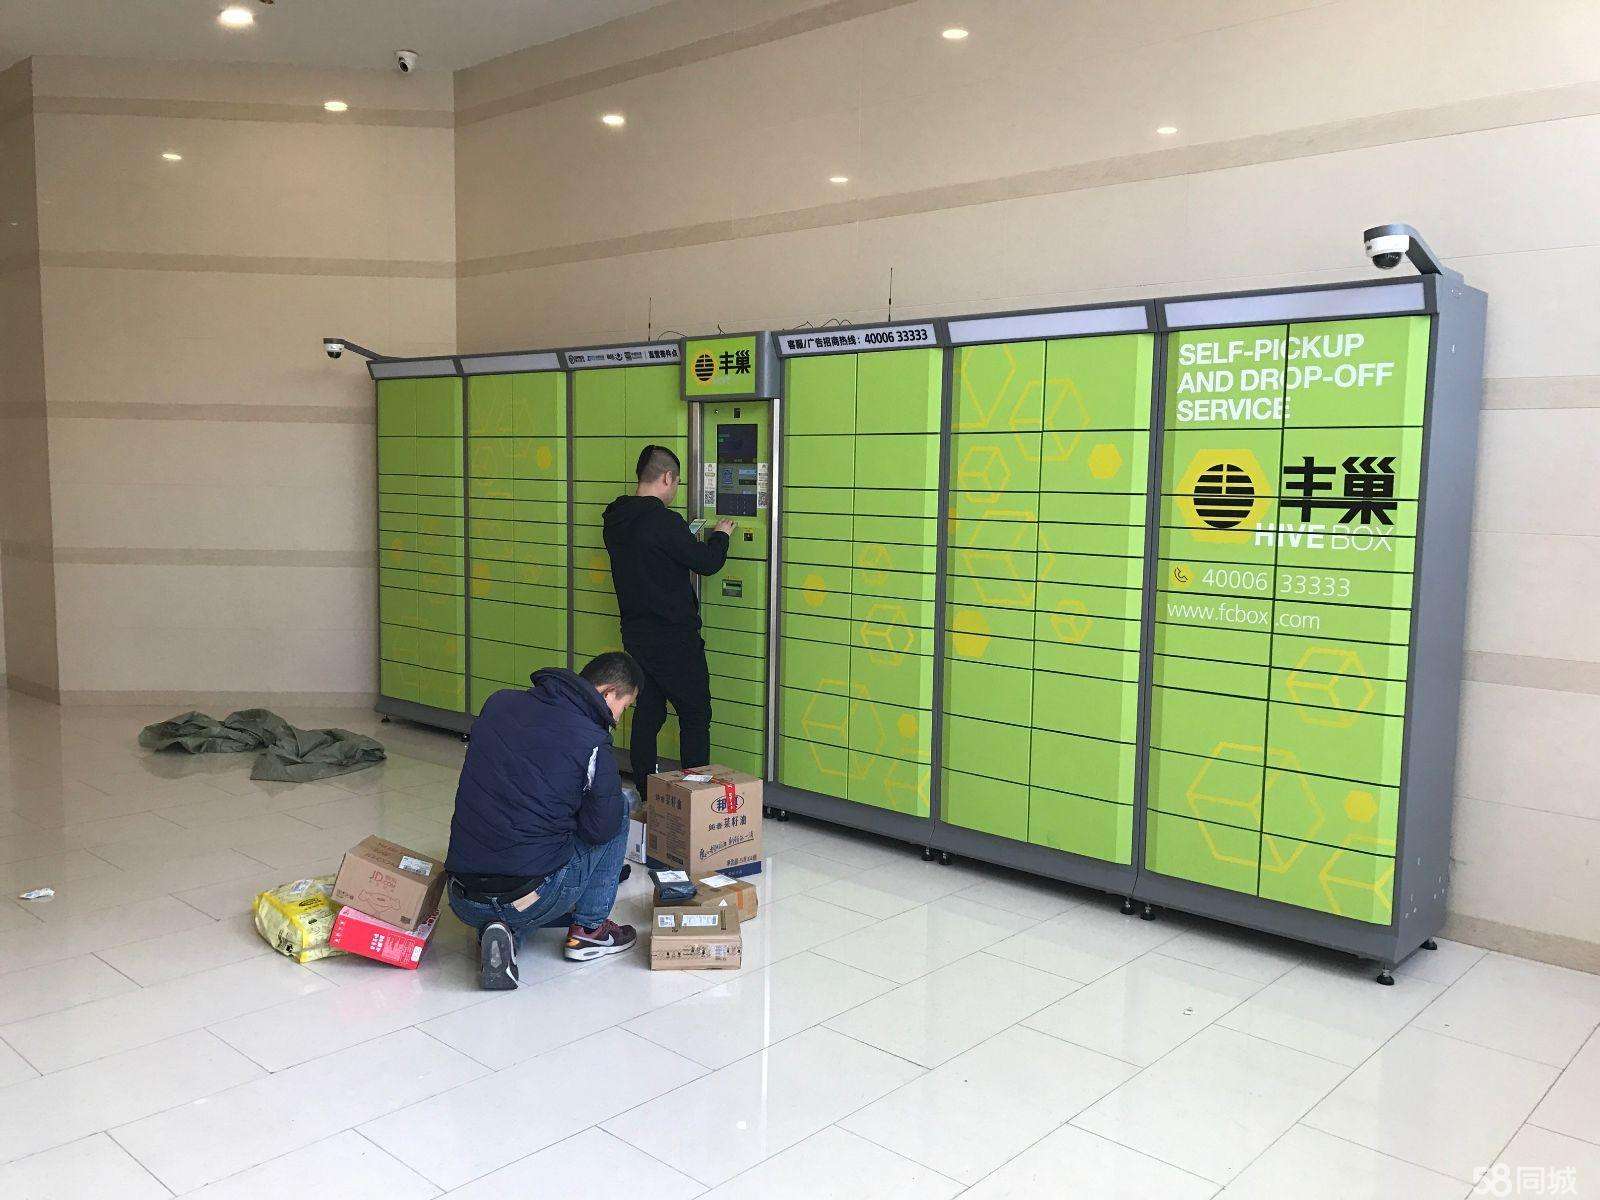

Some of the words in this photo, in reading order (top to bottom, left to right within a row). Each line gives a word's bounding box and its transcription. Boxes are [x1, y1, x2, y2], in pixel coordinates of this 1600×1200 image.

[864, 331, 895, 345] 40006
[896, 328, 928, 342] 33333
[1178, 333, 1365, 366] SELF-PICKUP
[718, 349, 752, 375] 丰巢
[1176, 370, 1233, 394] AND
[1240, 362, 1395, 392] DROP-OFF
[1176, 396, 1292, 423] SERVICE
[1280, 456, 1398, 526] 丰巢
[1253, 522, 1325, 549] HIVE
[1331, 525, 1393, 552] BOX
[1201, 568, 1268, 591] 40006
[1280, 574, 1351, 598] 33333
